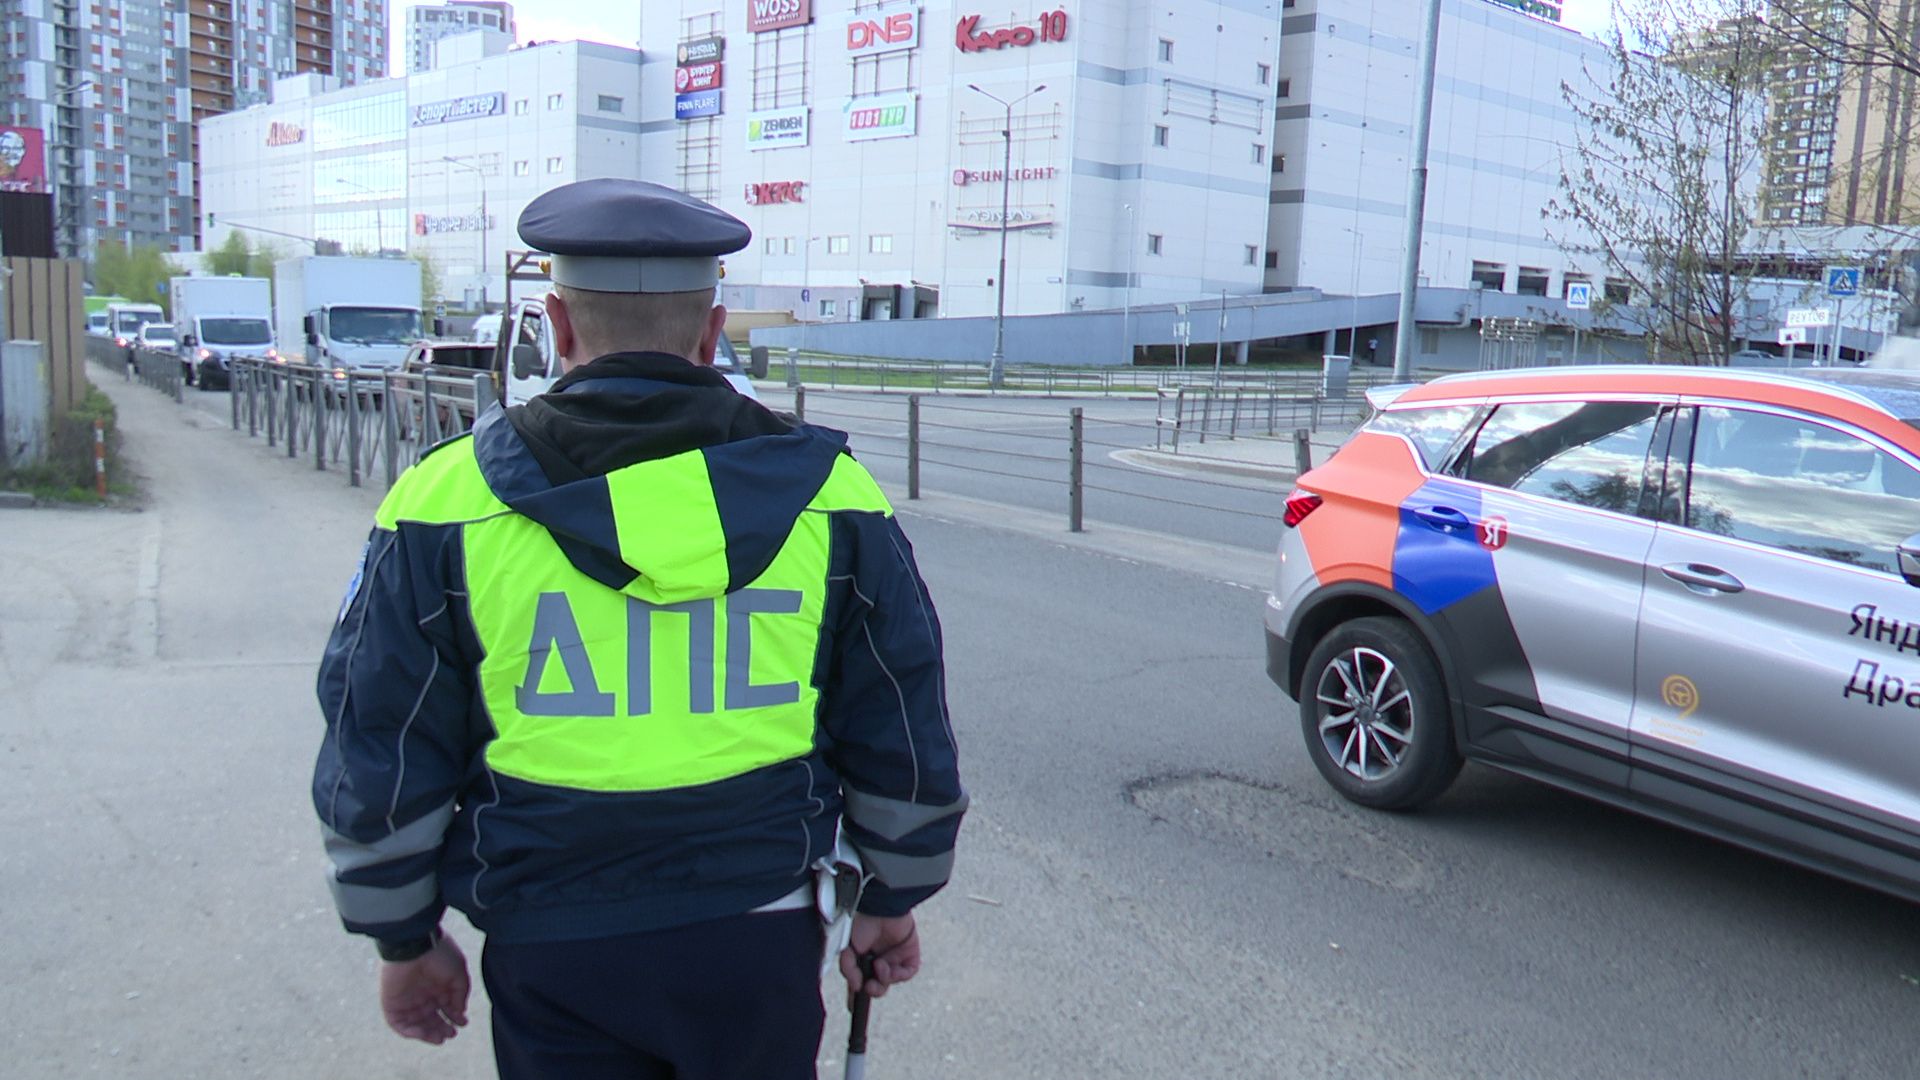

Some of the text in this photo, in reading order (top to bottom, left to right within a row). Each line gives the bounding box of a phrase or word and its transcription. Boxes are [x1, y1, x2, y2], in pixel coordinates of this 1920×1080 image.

[754, 0, 801, 17] WOSS
[847, 13, 912, 50] DNS
[1040, 10, 1066, 42] 10
[695, 97, 717, 109] FLARE
[763, 116, 802, 132] ZENDEN
[755, 181, 804, 205] KFC
[515, 587, 803, 717] ДПС
